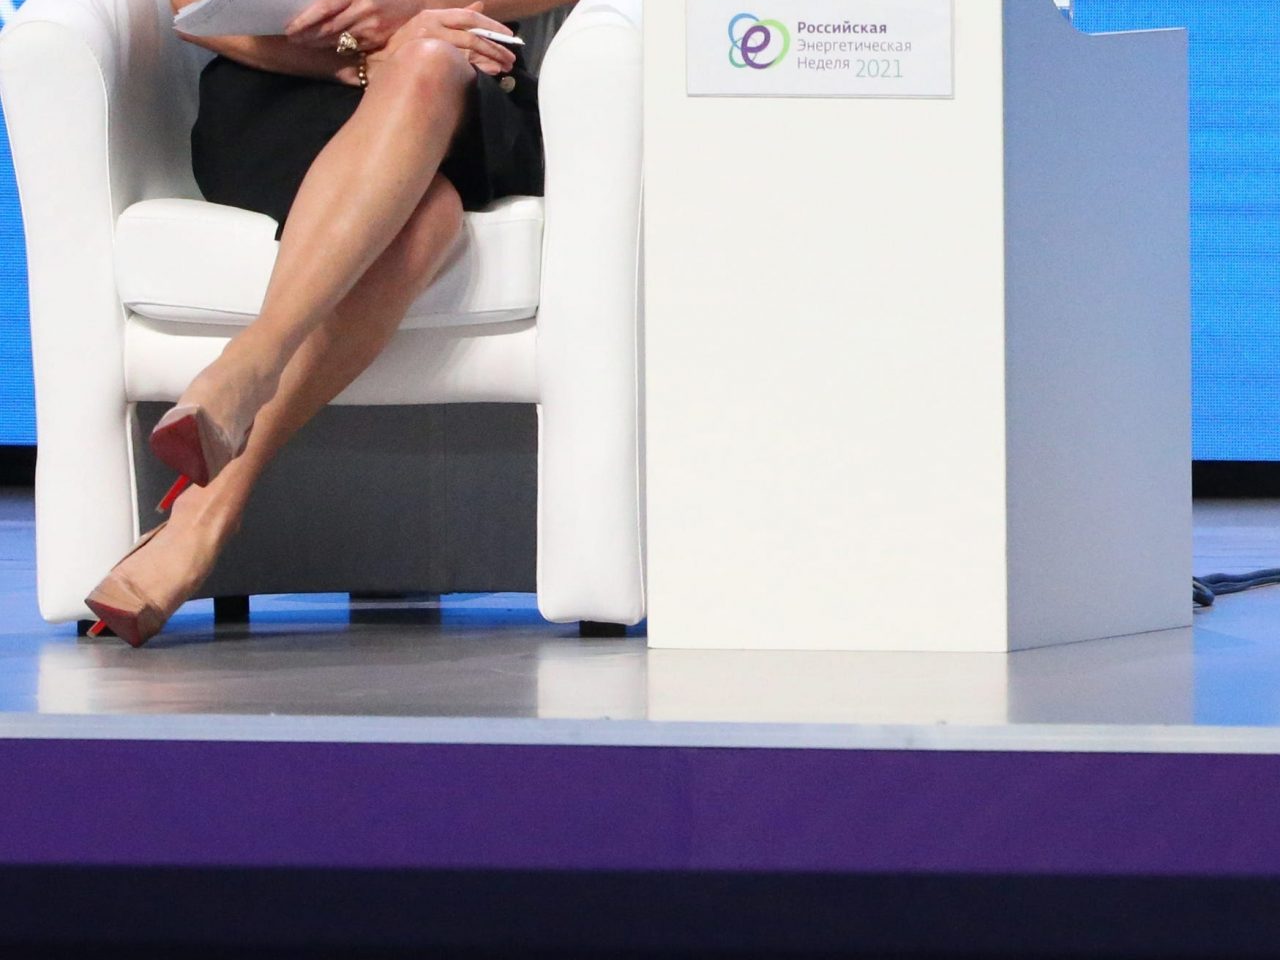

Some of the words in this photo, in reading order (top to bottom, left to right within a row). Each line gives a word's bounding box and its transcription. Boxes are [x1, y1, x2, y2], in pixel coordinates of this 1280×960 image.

[797, 21, 887, 34] Российская
[797, 39, 912, 53] Энергетическая
[797, 57, 850, 70] Неделя
[855, 59, 903, 78] 2021
